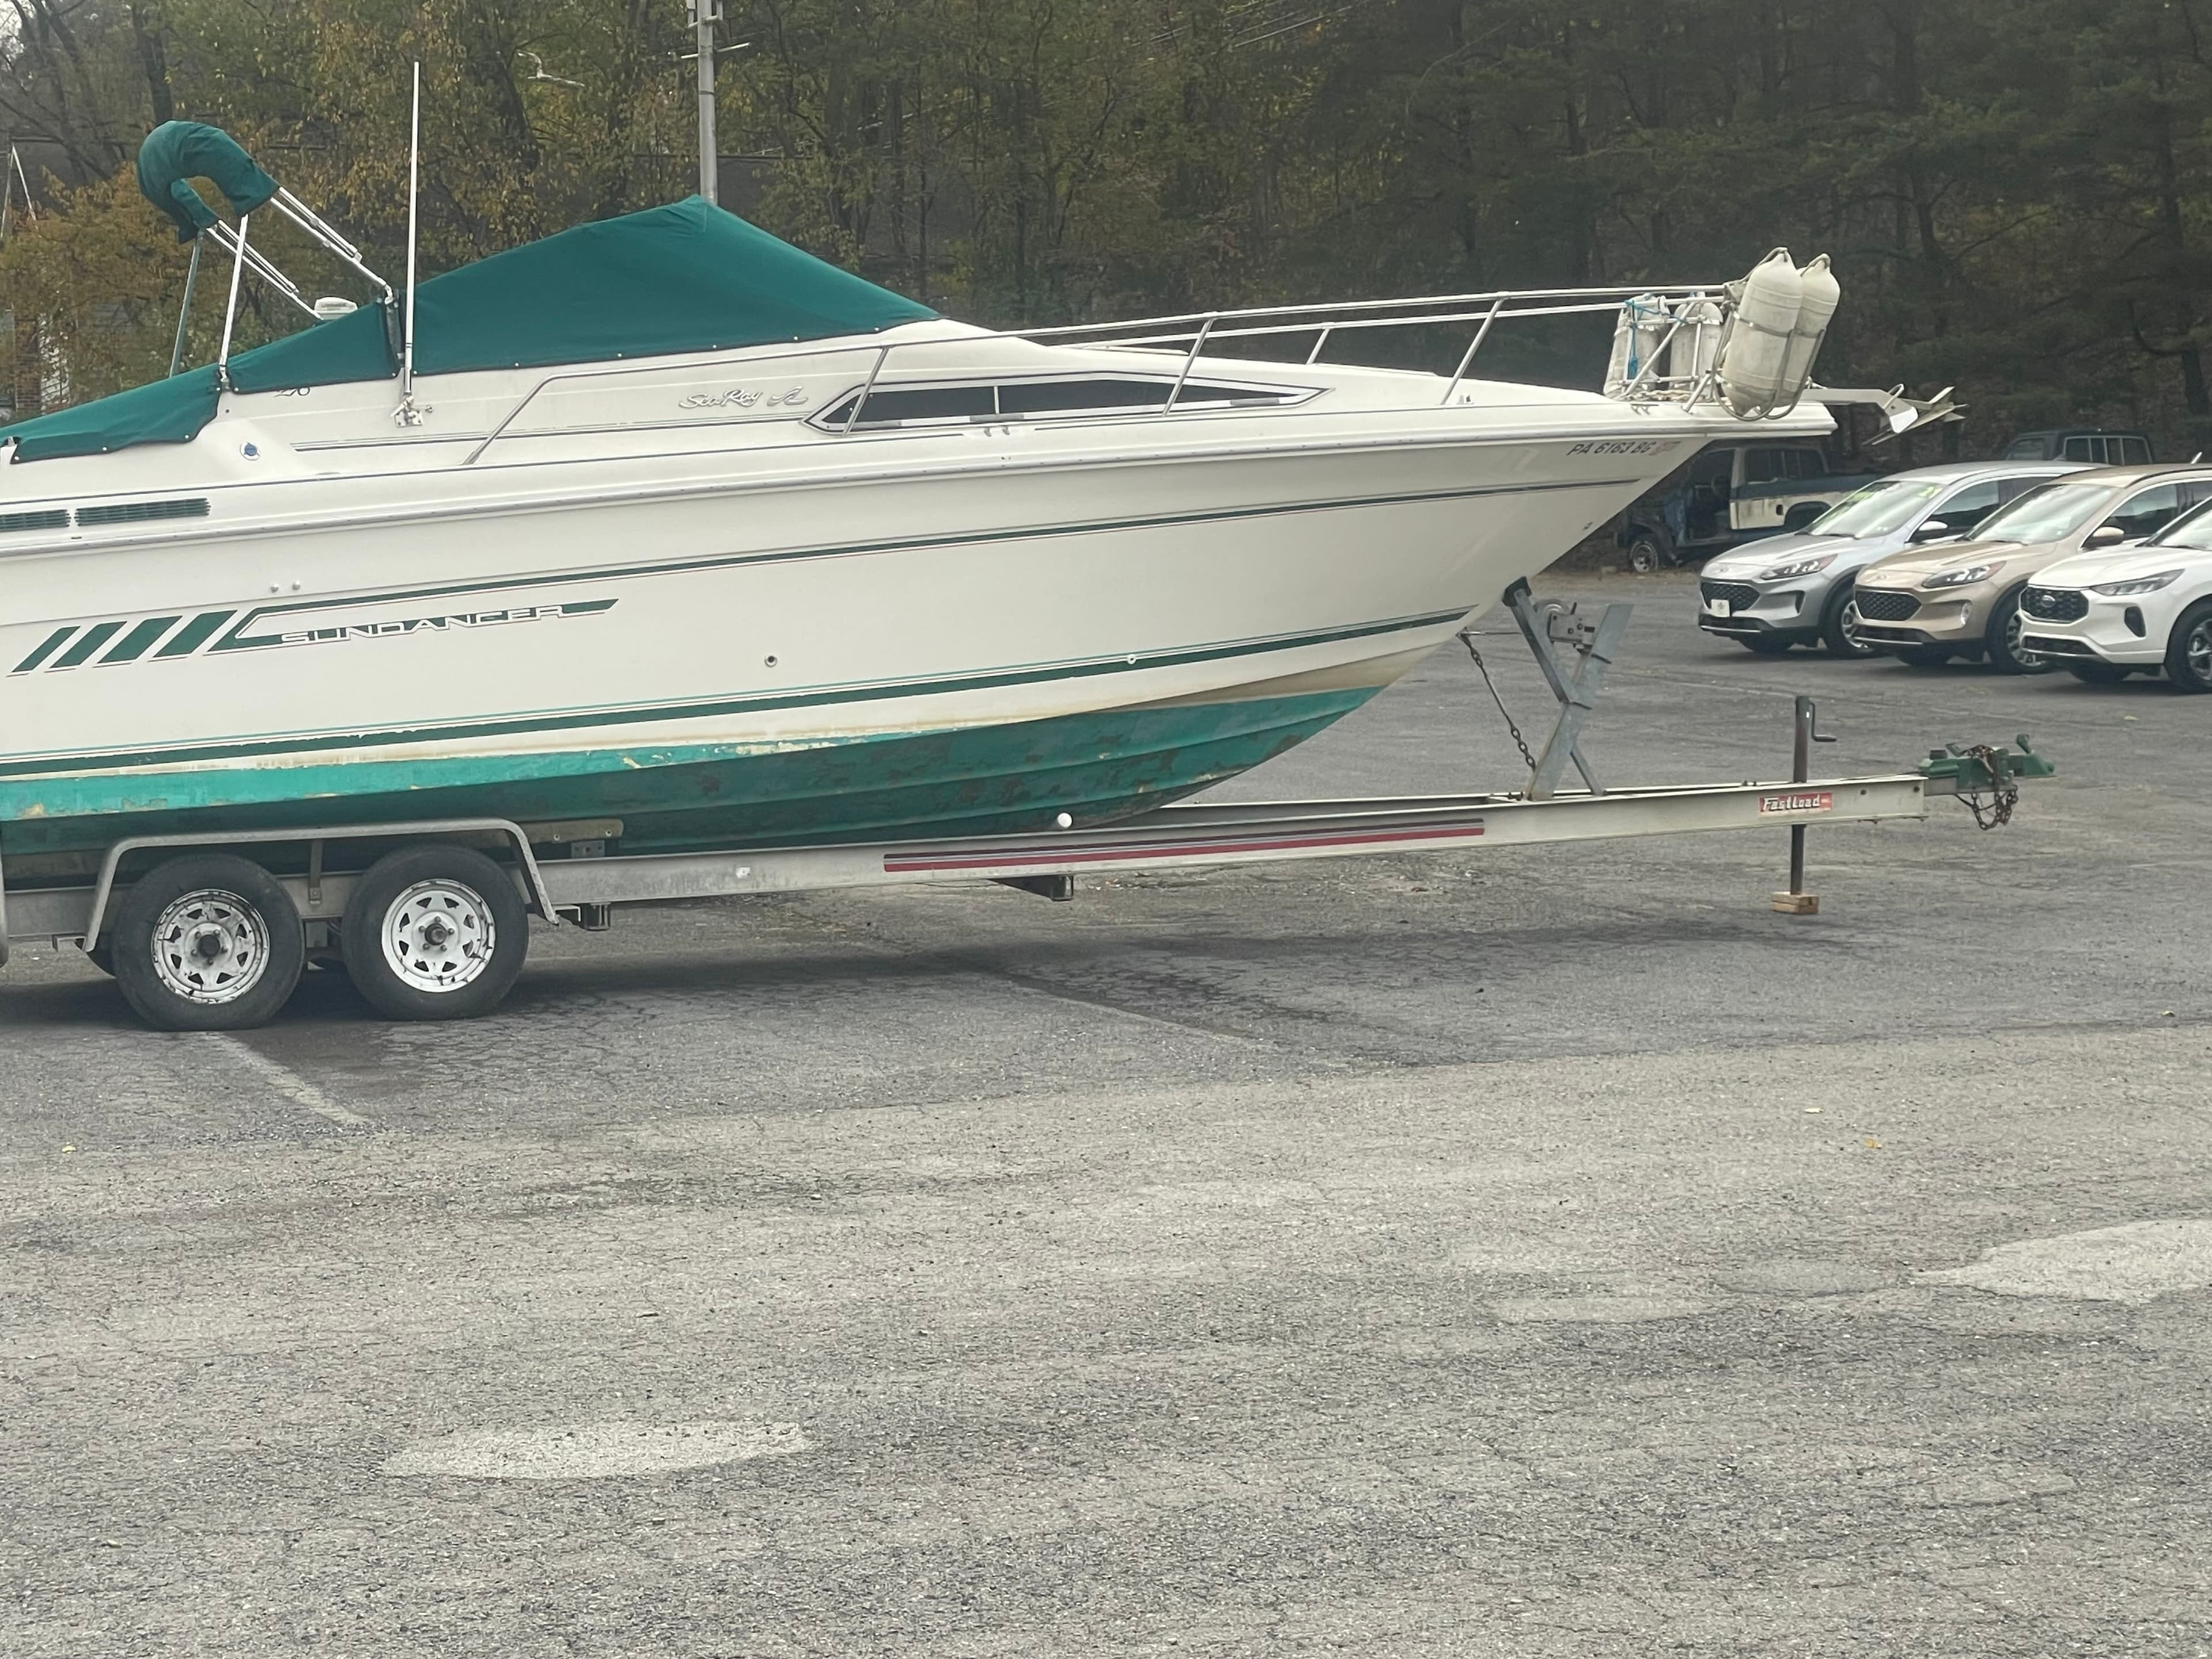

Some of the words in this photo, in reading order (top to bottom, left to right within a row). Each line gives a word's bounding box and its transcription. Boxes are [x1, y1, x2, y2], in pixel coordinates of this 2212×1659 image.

[1566, 442, 1595, 456] PA
[1594, 441, 1636, 454] 6163
[281, 605, 563, 643] SUNDANCER
